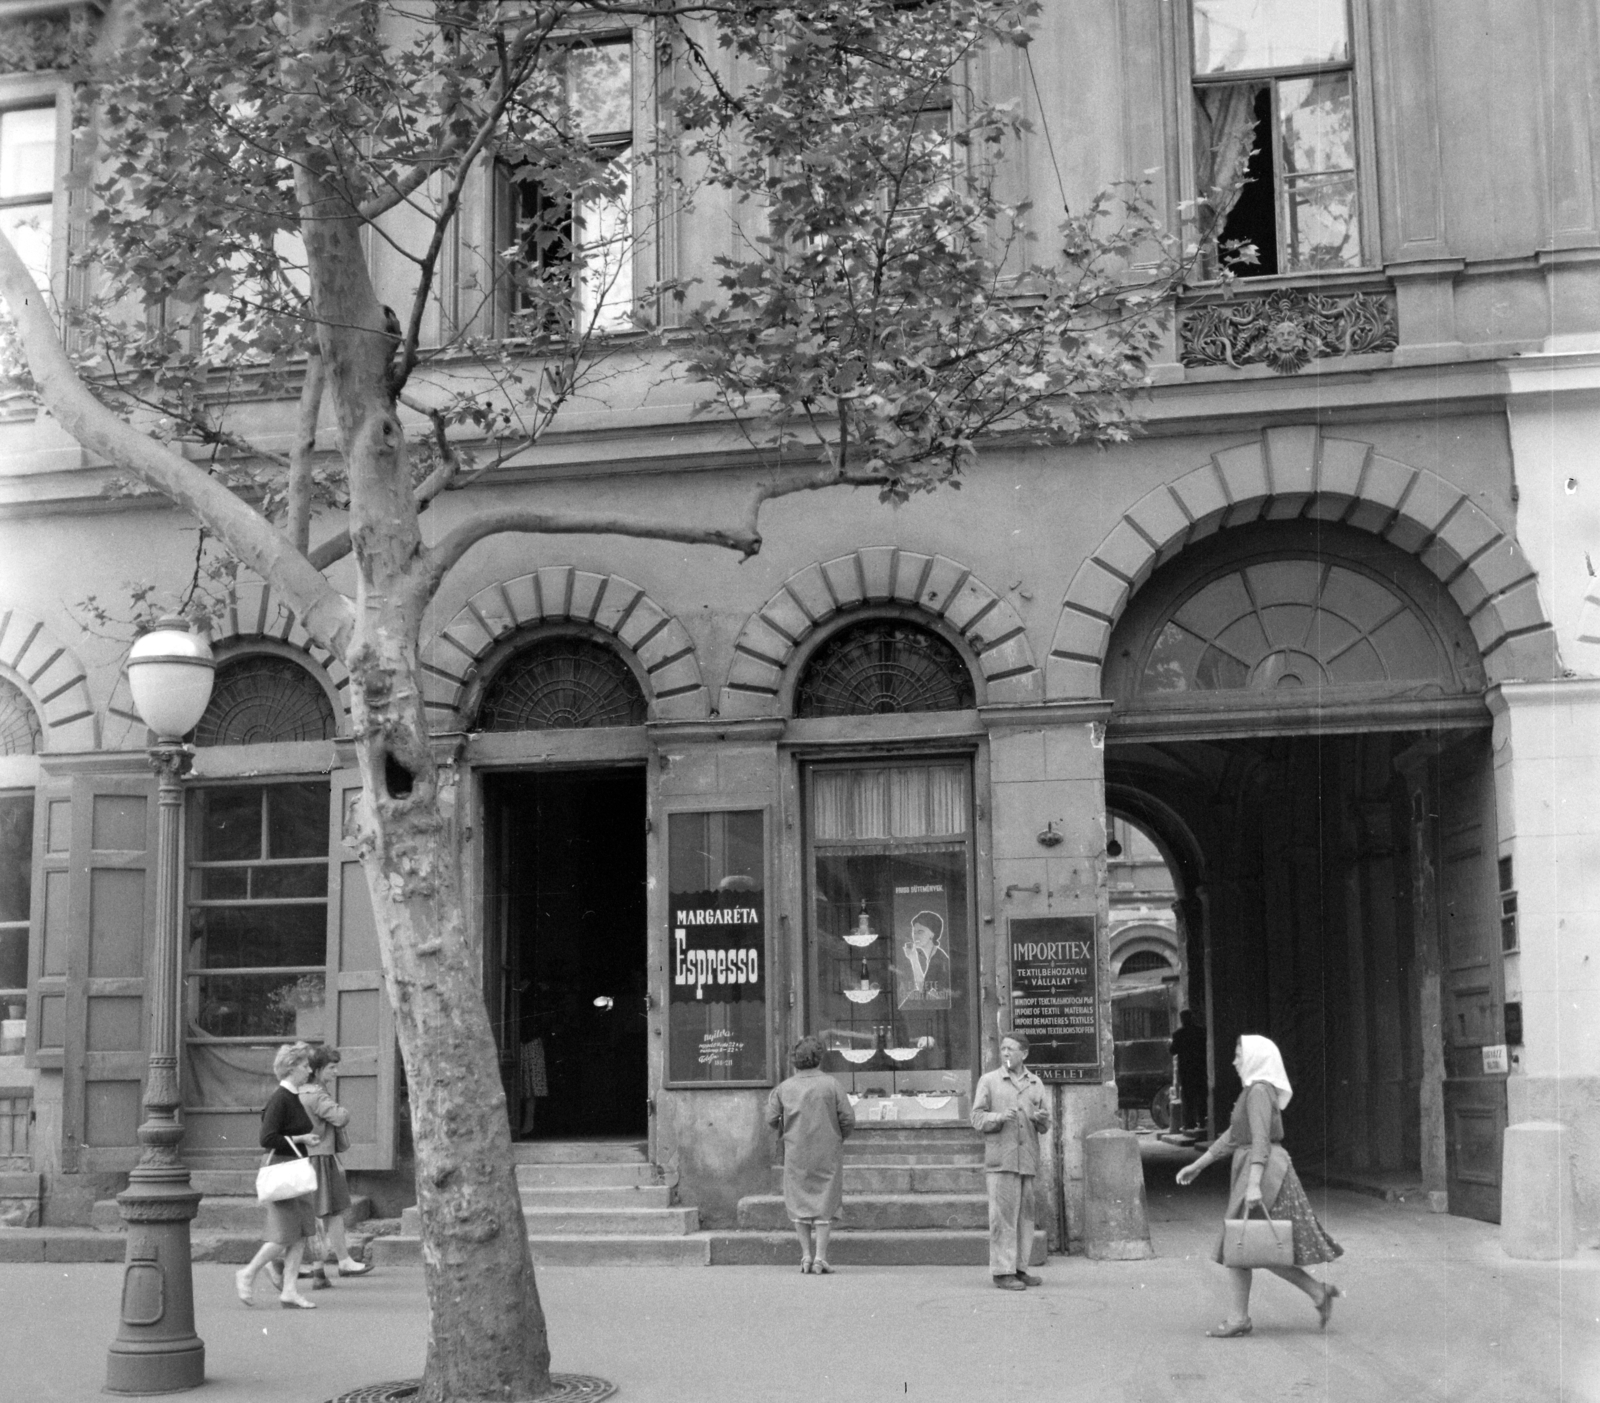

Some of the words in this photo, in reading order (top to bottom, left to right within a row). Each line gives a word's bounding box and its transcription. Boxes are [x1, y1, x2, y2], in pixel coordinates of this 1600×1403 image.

[677, 905, 758, 925] MARGARÉTA
[1013, 941, 1091, 961] IMPORTTEX
[675, 928, 758, 999] Espresso
[1016, 967, 1087, 976] TEXTILBEHOZATALI
[1031, 975, 1072, 986] VÁLLALAT
[1014, 1007, 1033, 1015] IMPORT
[1033, 1007, 1040, 1015] OF
[1064, 1006, 1094, 1014] MATERIALS
[1014, 1017, 1033, 1025] IMPORT
[1033, 1017, 1040, 1025] DE
[1069, 1016, 1094, 1024] TEXTILES
